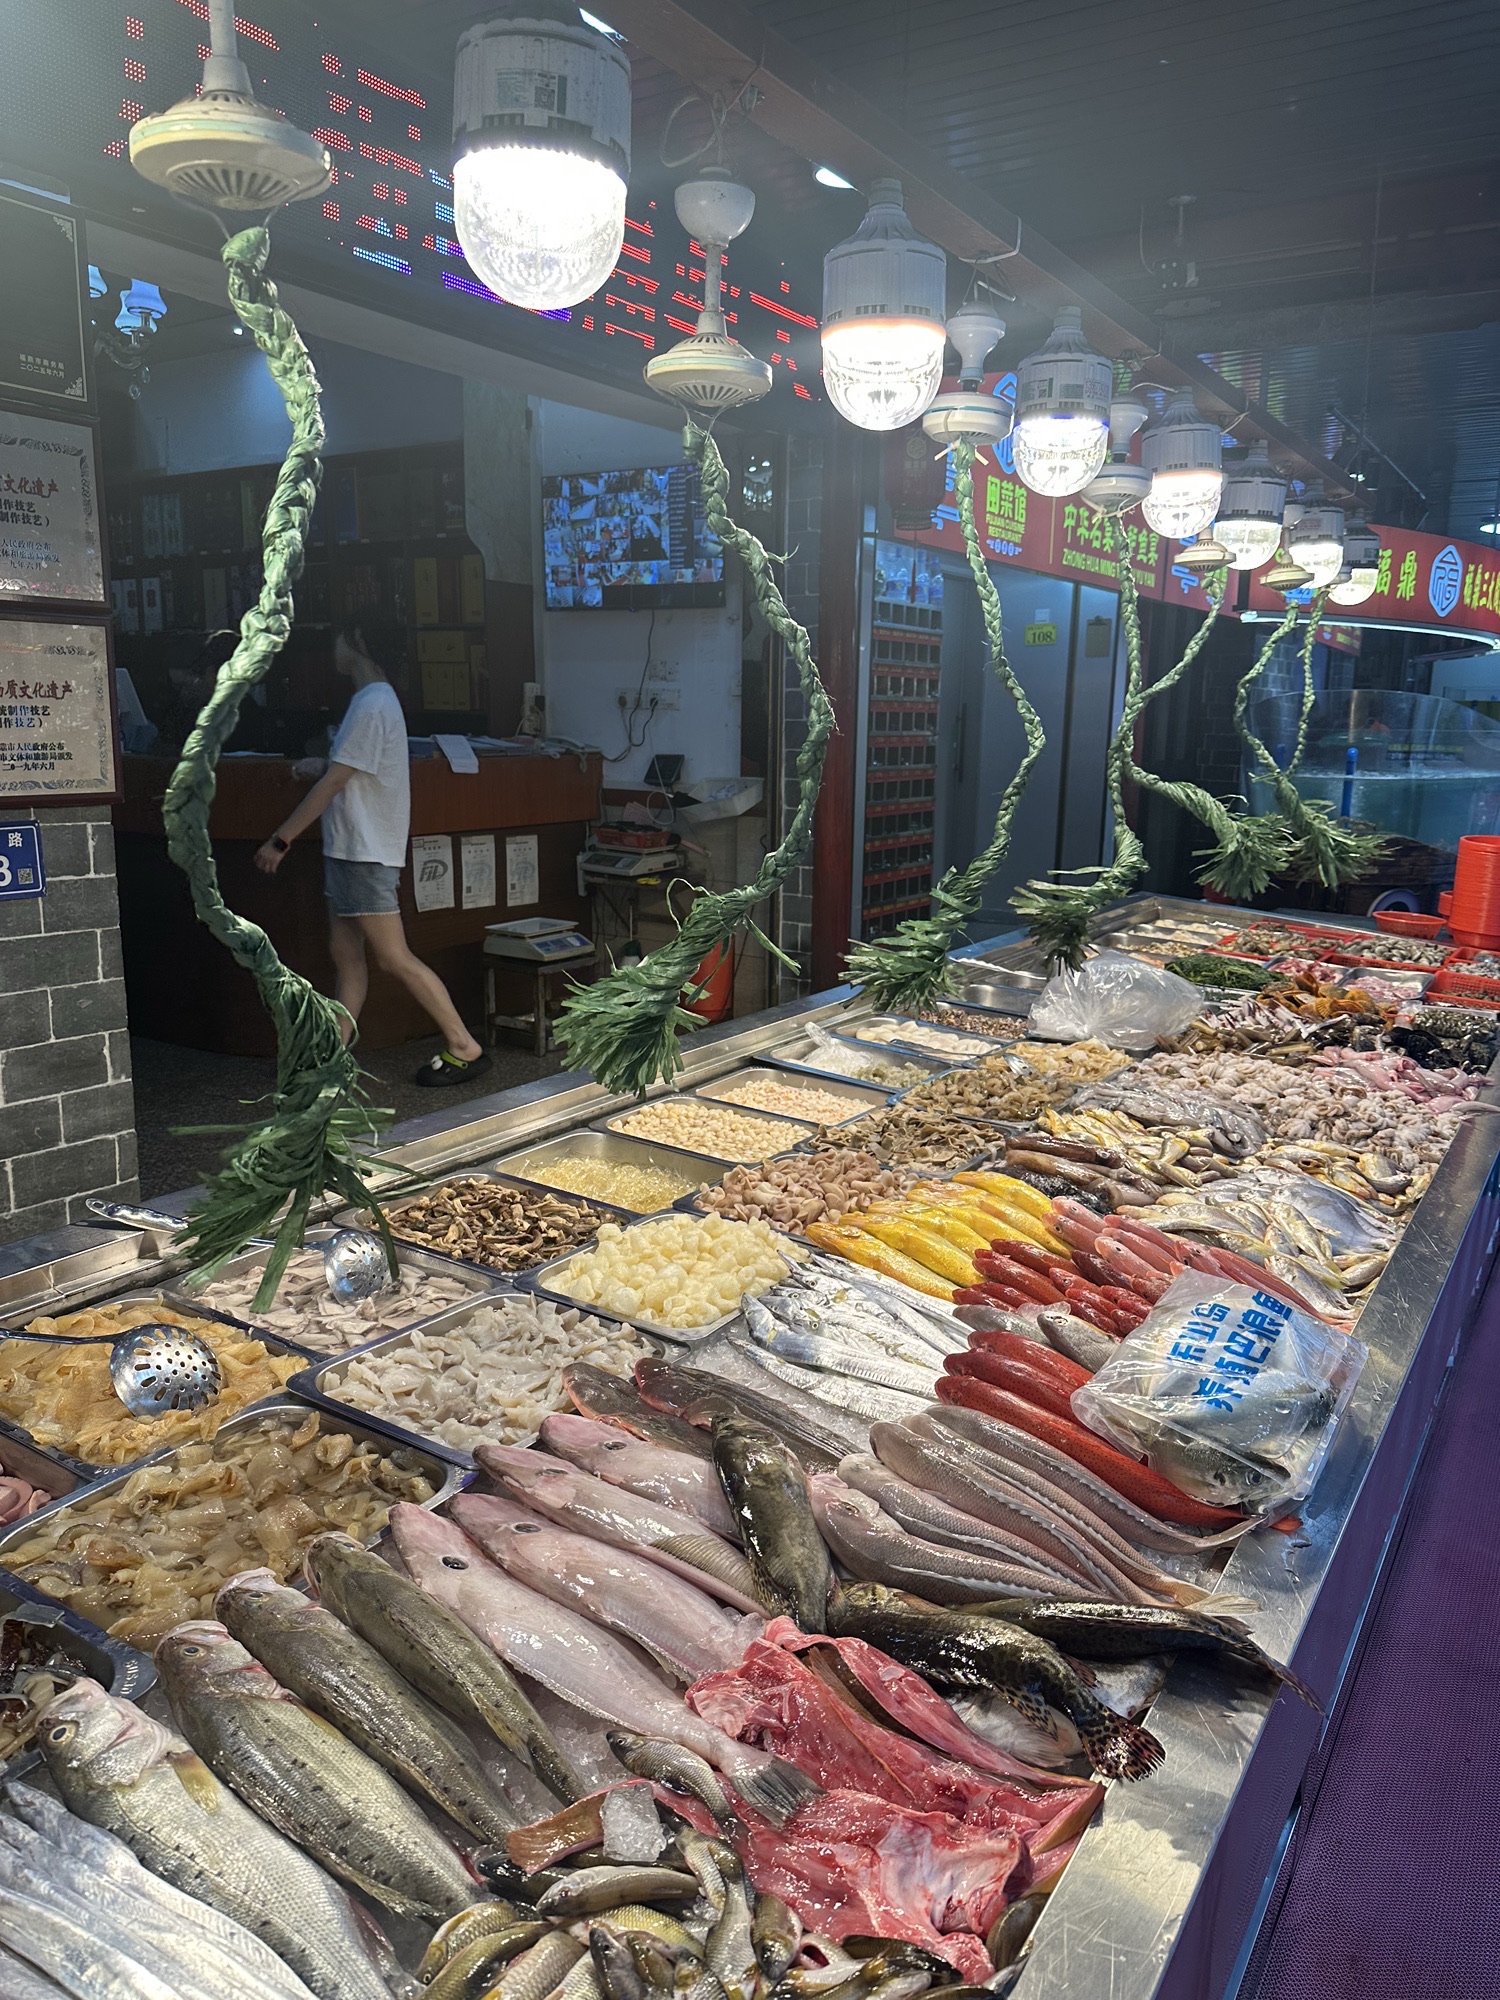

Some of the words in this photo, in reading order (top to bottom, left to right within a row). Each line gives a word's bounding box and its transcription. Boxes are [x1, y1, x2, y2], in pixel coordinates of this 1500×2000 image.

[0, 473, 59, 499] 文化遗产
[0, 498, 36, 513] 作技艺
[0, 548, 60, 563] 体和旅游局颁发
[1032, 631, 1053, 643] 108
[8, 832, 22, 847] 路
